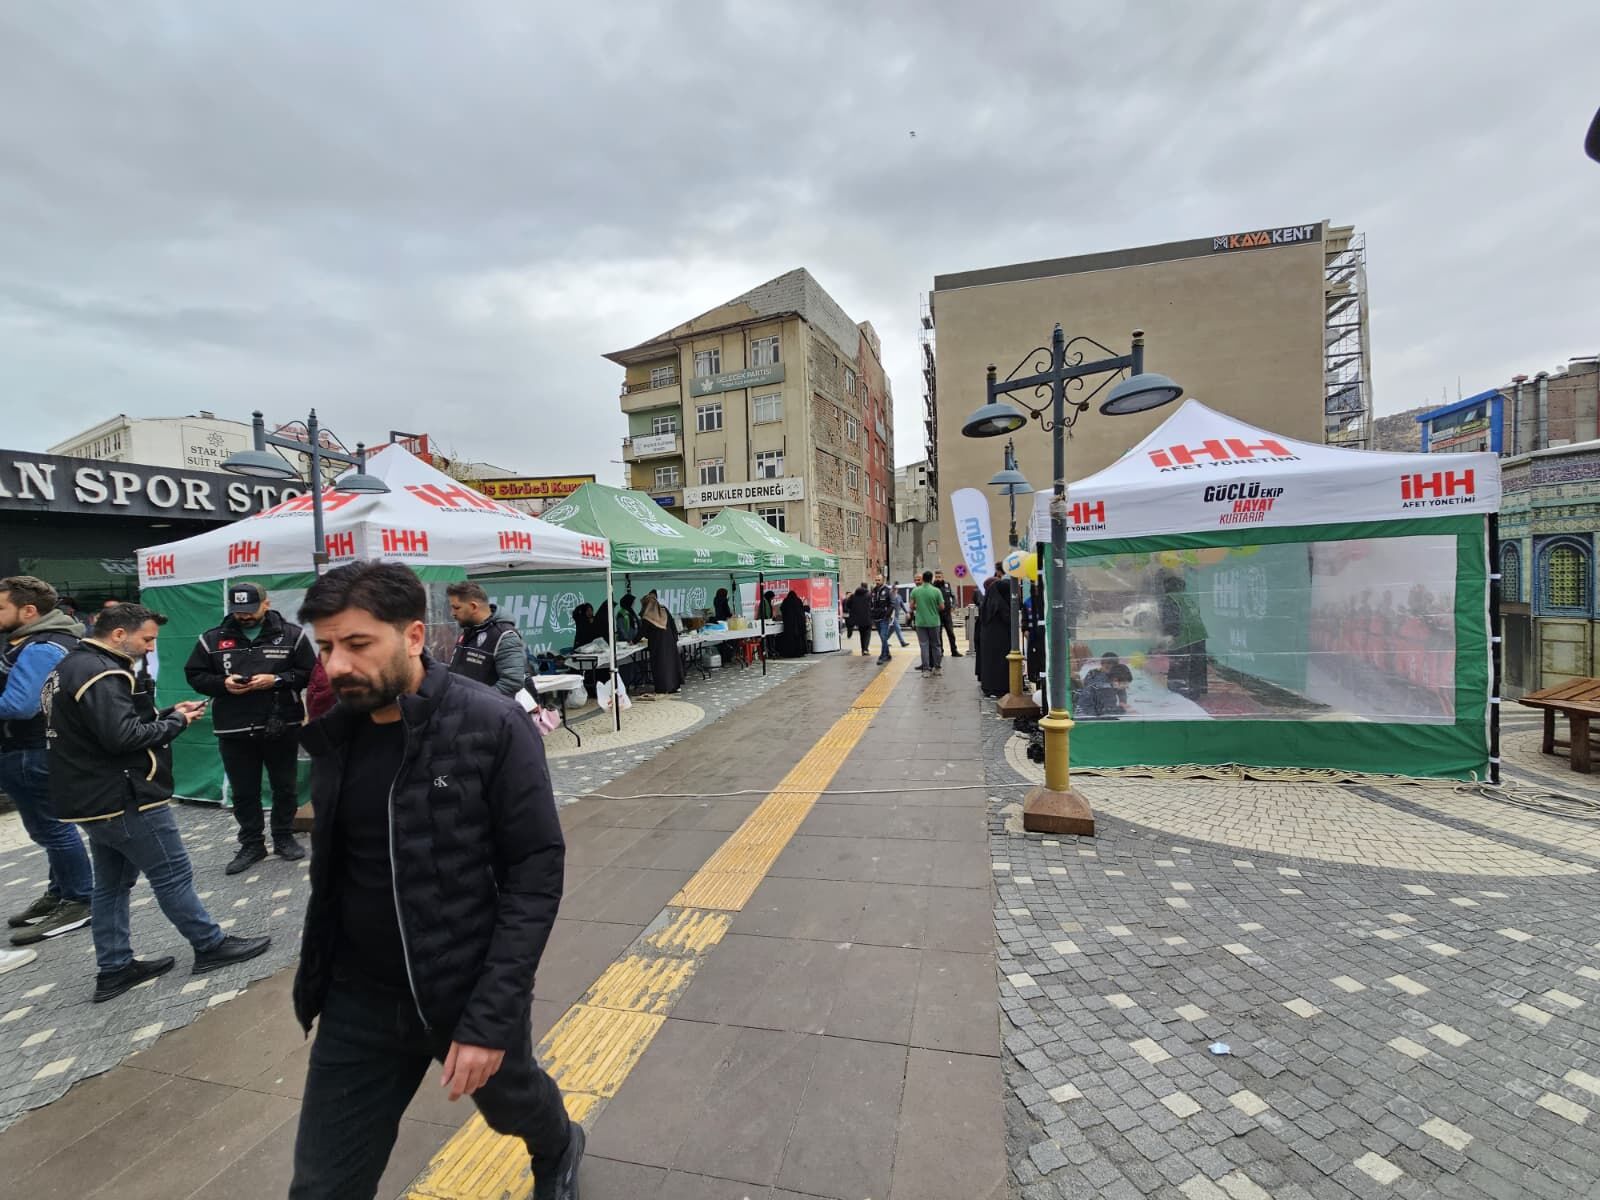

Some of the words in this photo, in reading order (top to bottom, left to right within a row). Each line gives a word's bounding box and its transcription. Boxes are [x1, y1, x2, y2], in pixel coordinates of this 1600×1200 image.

[190, 445, 217, 457] STAR
[1159, 463, 1204, 473] AFET
[75, 467, 216, 511] SPOR
[1203, 482, 1260, 503] GÜÇLÜ
[1233, 498, 1275, 512] HAYAT
[1402, 500, 1427, 508] AFET
[1219, 511, 1265, 525] KURTARIR
